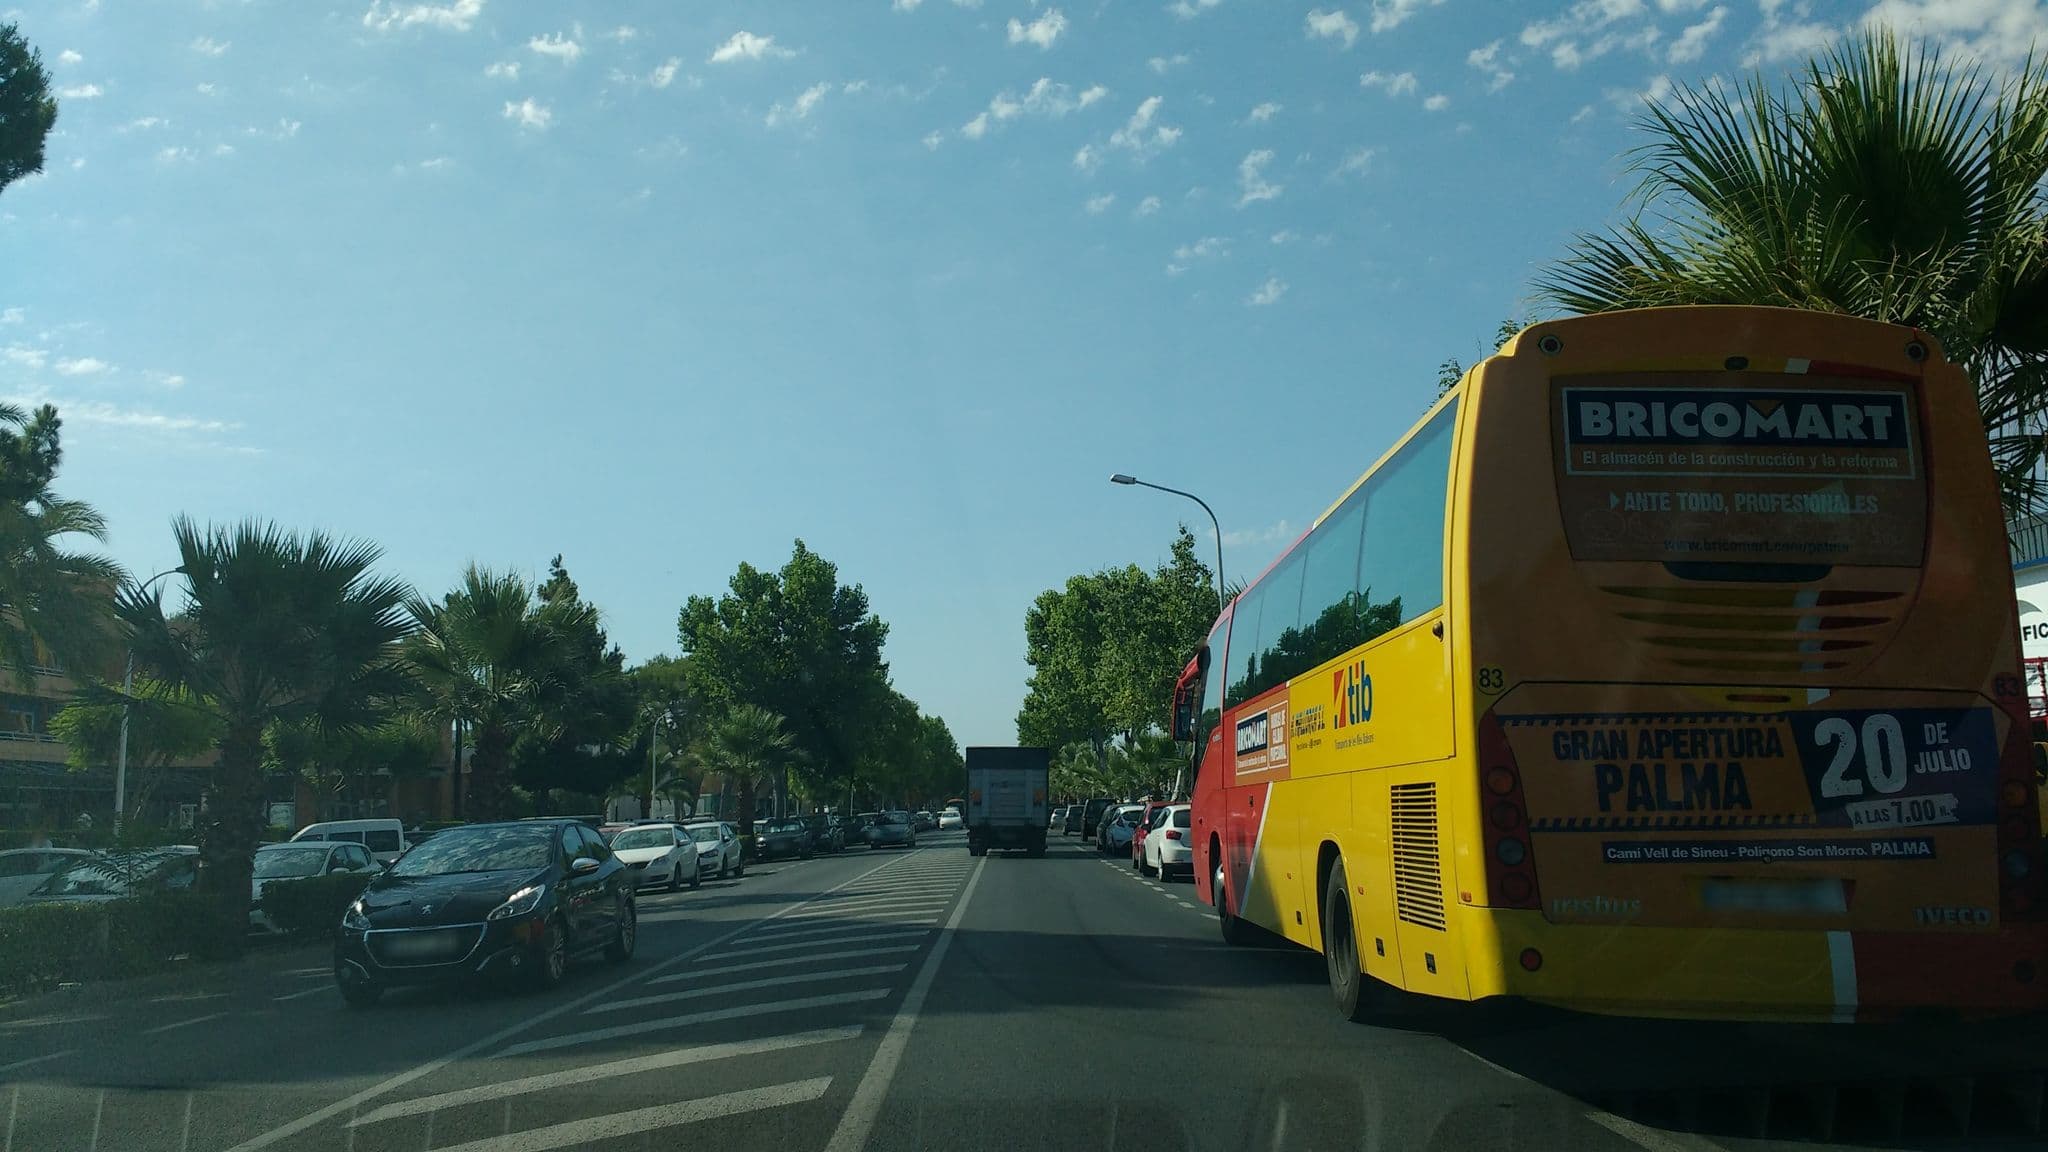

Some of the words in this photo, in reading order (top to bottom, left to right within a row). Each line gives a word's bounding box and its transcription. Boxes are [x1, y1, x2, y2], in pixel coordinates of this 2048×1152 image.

[1580, 401, 1893, 440] BRICOMART
[1583, 451, 1596, 464] El
[1601, 451, 1664, 464] almacén
[1669, 451, 1687, 465] de
[1691, 452, 1704, 465] la
[1709, 452, 1805, 466] construcción
[1808, 456, 1817, 469] y
[1822, 453, 1835, 466] la
[1840, 453, 1898, 468] reforma
[1624, 492, 1672, 511] ANTE
[1734, 492, 1879, 513] PROFESIONALES
[1479, 668, 1504, 688] 83
[1347, 660, 1373, 725] tib
[1552, 729, 1629, 760] GRAN
[1637, 727, 1784, 759] APERTURA
[1923, 722, 1949, 745] DE
[1814, 713, 1907, 798] 20
[1914, 748, 1971, 774] JULIO
[1594, 762, 1752, 812] PALMA
[1854, 810, 1863, 825] A
[1865, 808, 1889, 824] LAS
[1890, 799, 1936, 823] 7.00
[1671, 847, 1688, 858] de
[1690, 846, 1729, 858] Sineu
[1797, 845, 1823, 857] Son
[1871, 842, 1932, 856] PALMA
[1913, 906, 1992, 926] IVECO
